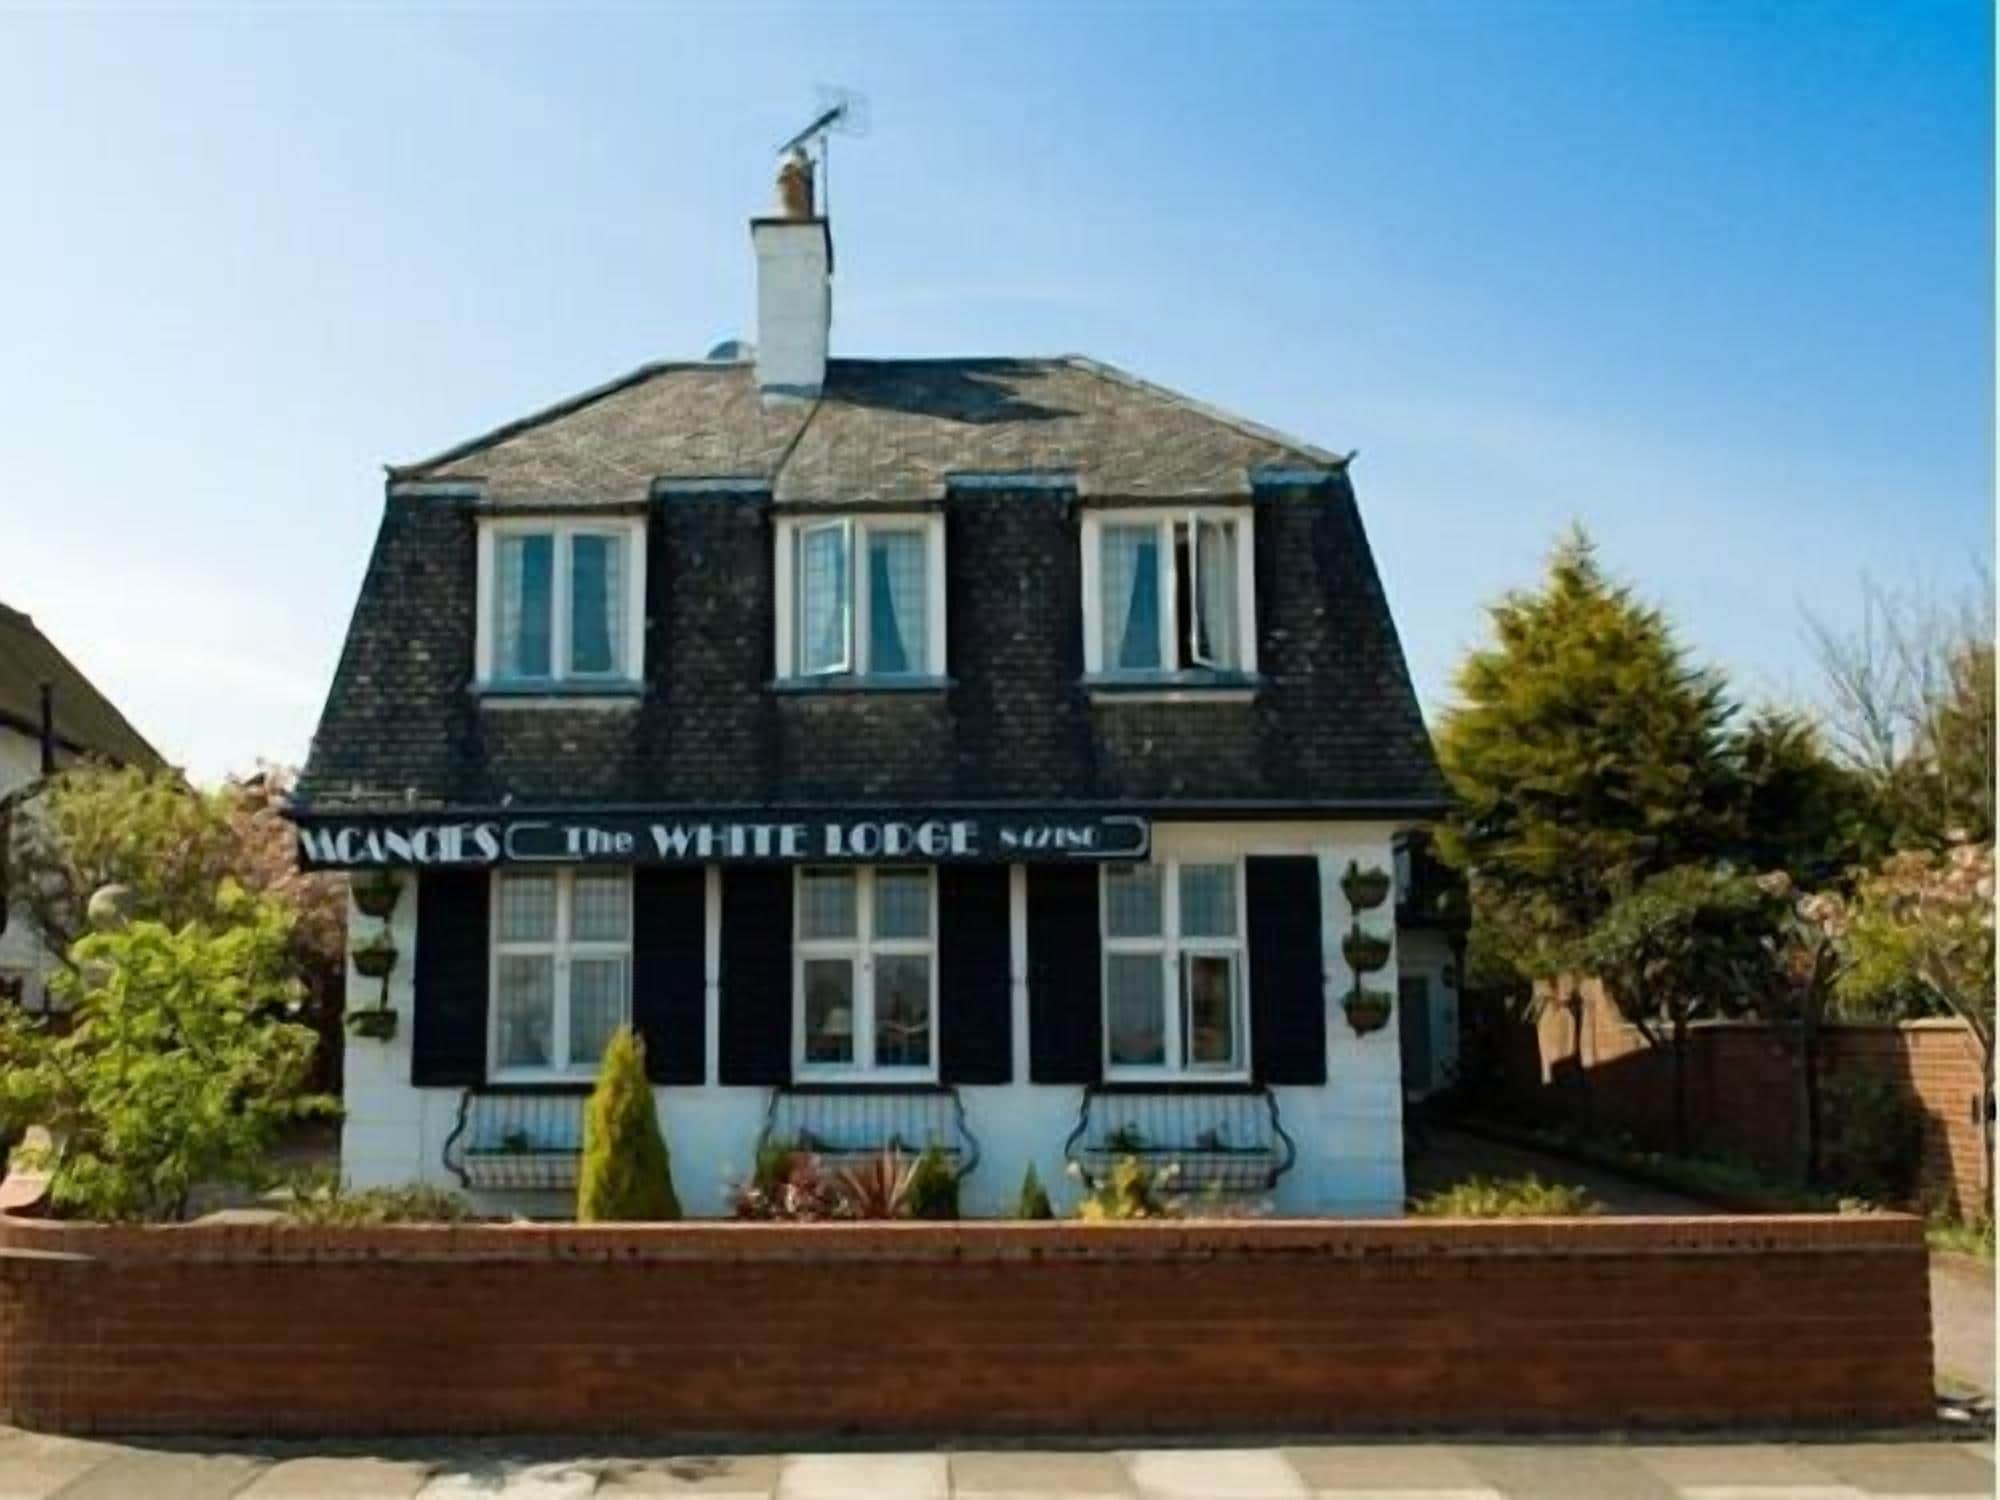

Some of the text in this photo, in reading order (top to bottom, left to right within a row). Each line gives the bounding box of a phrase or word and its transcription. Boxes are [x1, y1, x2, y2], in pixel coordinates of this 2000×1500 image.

[300, 823, 501, 863] VACANCIES
[563, 825, 633, 854] The
[650, 822, 807, 858] WHITE
[825, 820, 979, 856] LODGE
